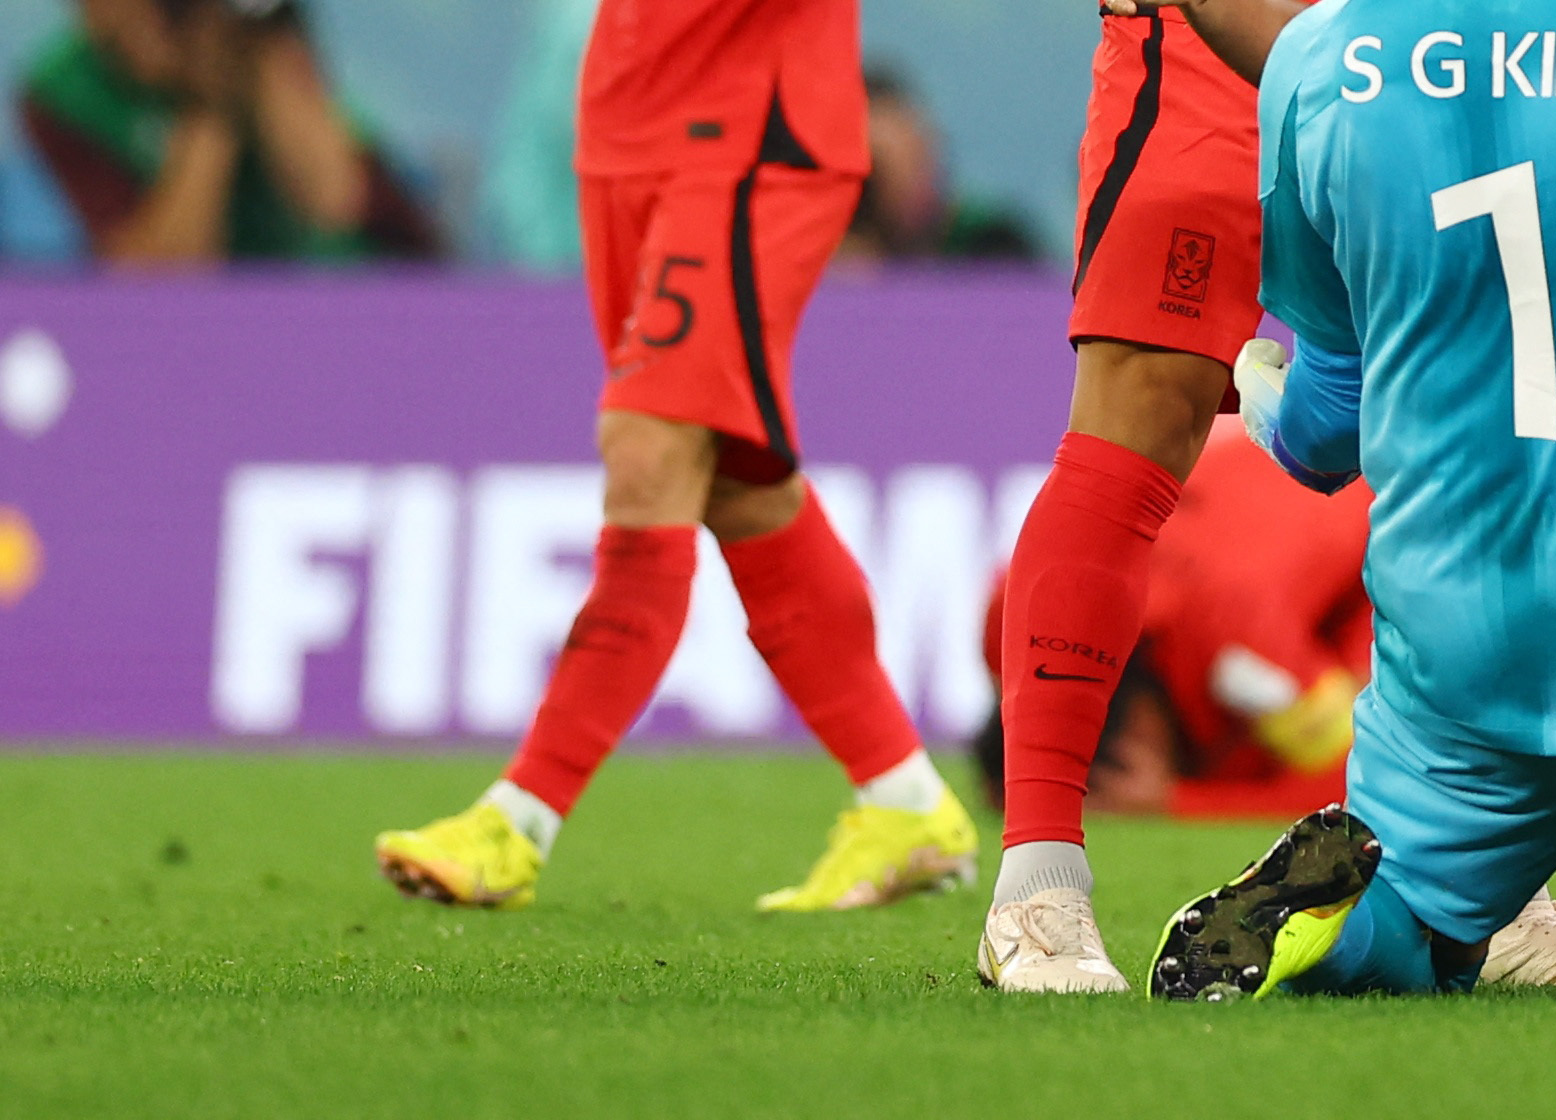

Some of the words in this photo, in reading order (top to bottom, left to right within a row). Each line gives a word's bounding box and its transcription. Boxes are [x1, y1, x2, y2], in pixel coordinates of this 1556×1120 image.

[1340, 34, 1384, 104] S
[1411, 31, 1467, 99] G
[1157, 299, 1202, 320] KOREA
[216, 465, 780, 737] FIFA
[1029, 634, 1119, 669] KOREA
